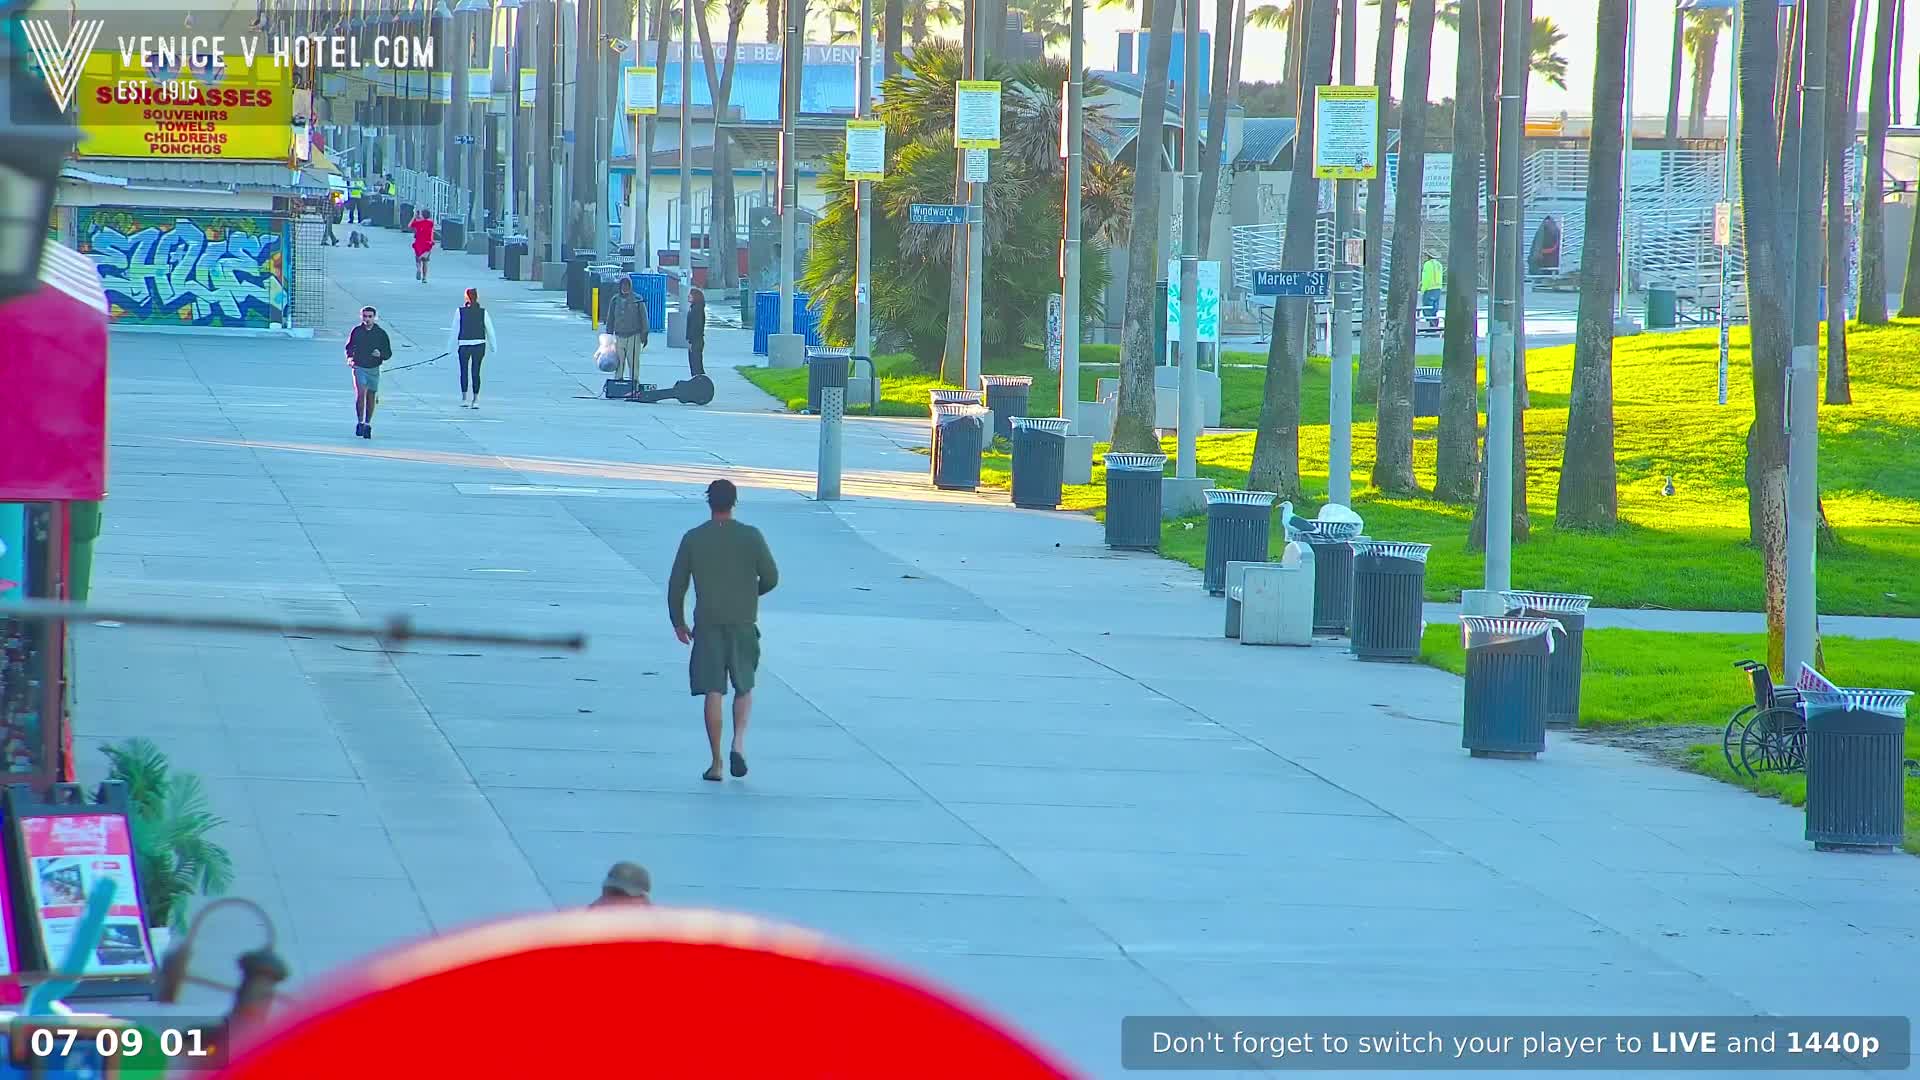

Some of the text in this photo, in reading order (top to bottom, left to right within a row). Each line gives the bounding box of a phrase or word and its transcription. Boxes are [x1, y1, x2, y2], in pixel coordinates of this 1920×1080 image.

[754, 47, 810, 61] BEAH
[820, 47, 882, 63] VENE
[143, 109, 228, 121] SOUVENIRS
[156, 121, 215, 132] TOWELS
[144, 132, 228, 144] CHILDRENS
[150, 143, 222, 154] PONCHOS
[913, 205, 953, 216] Windward
[1258, 271, 1325, 286] Market St
[1318, 285, 1325, 295] E
